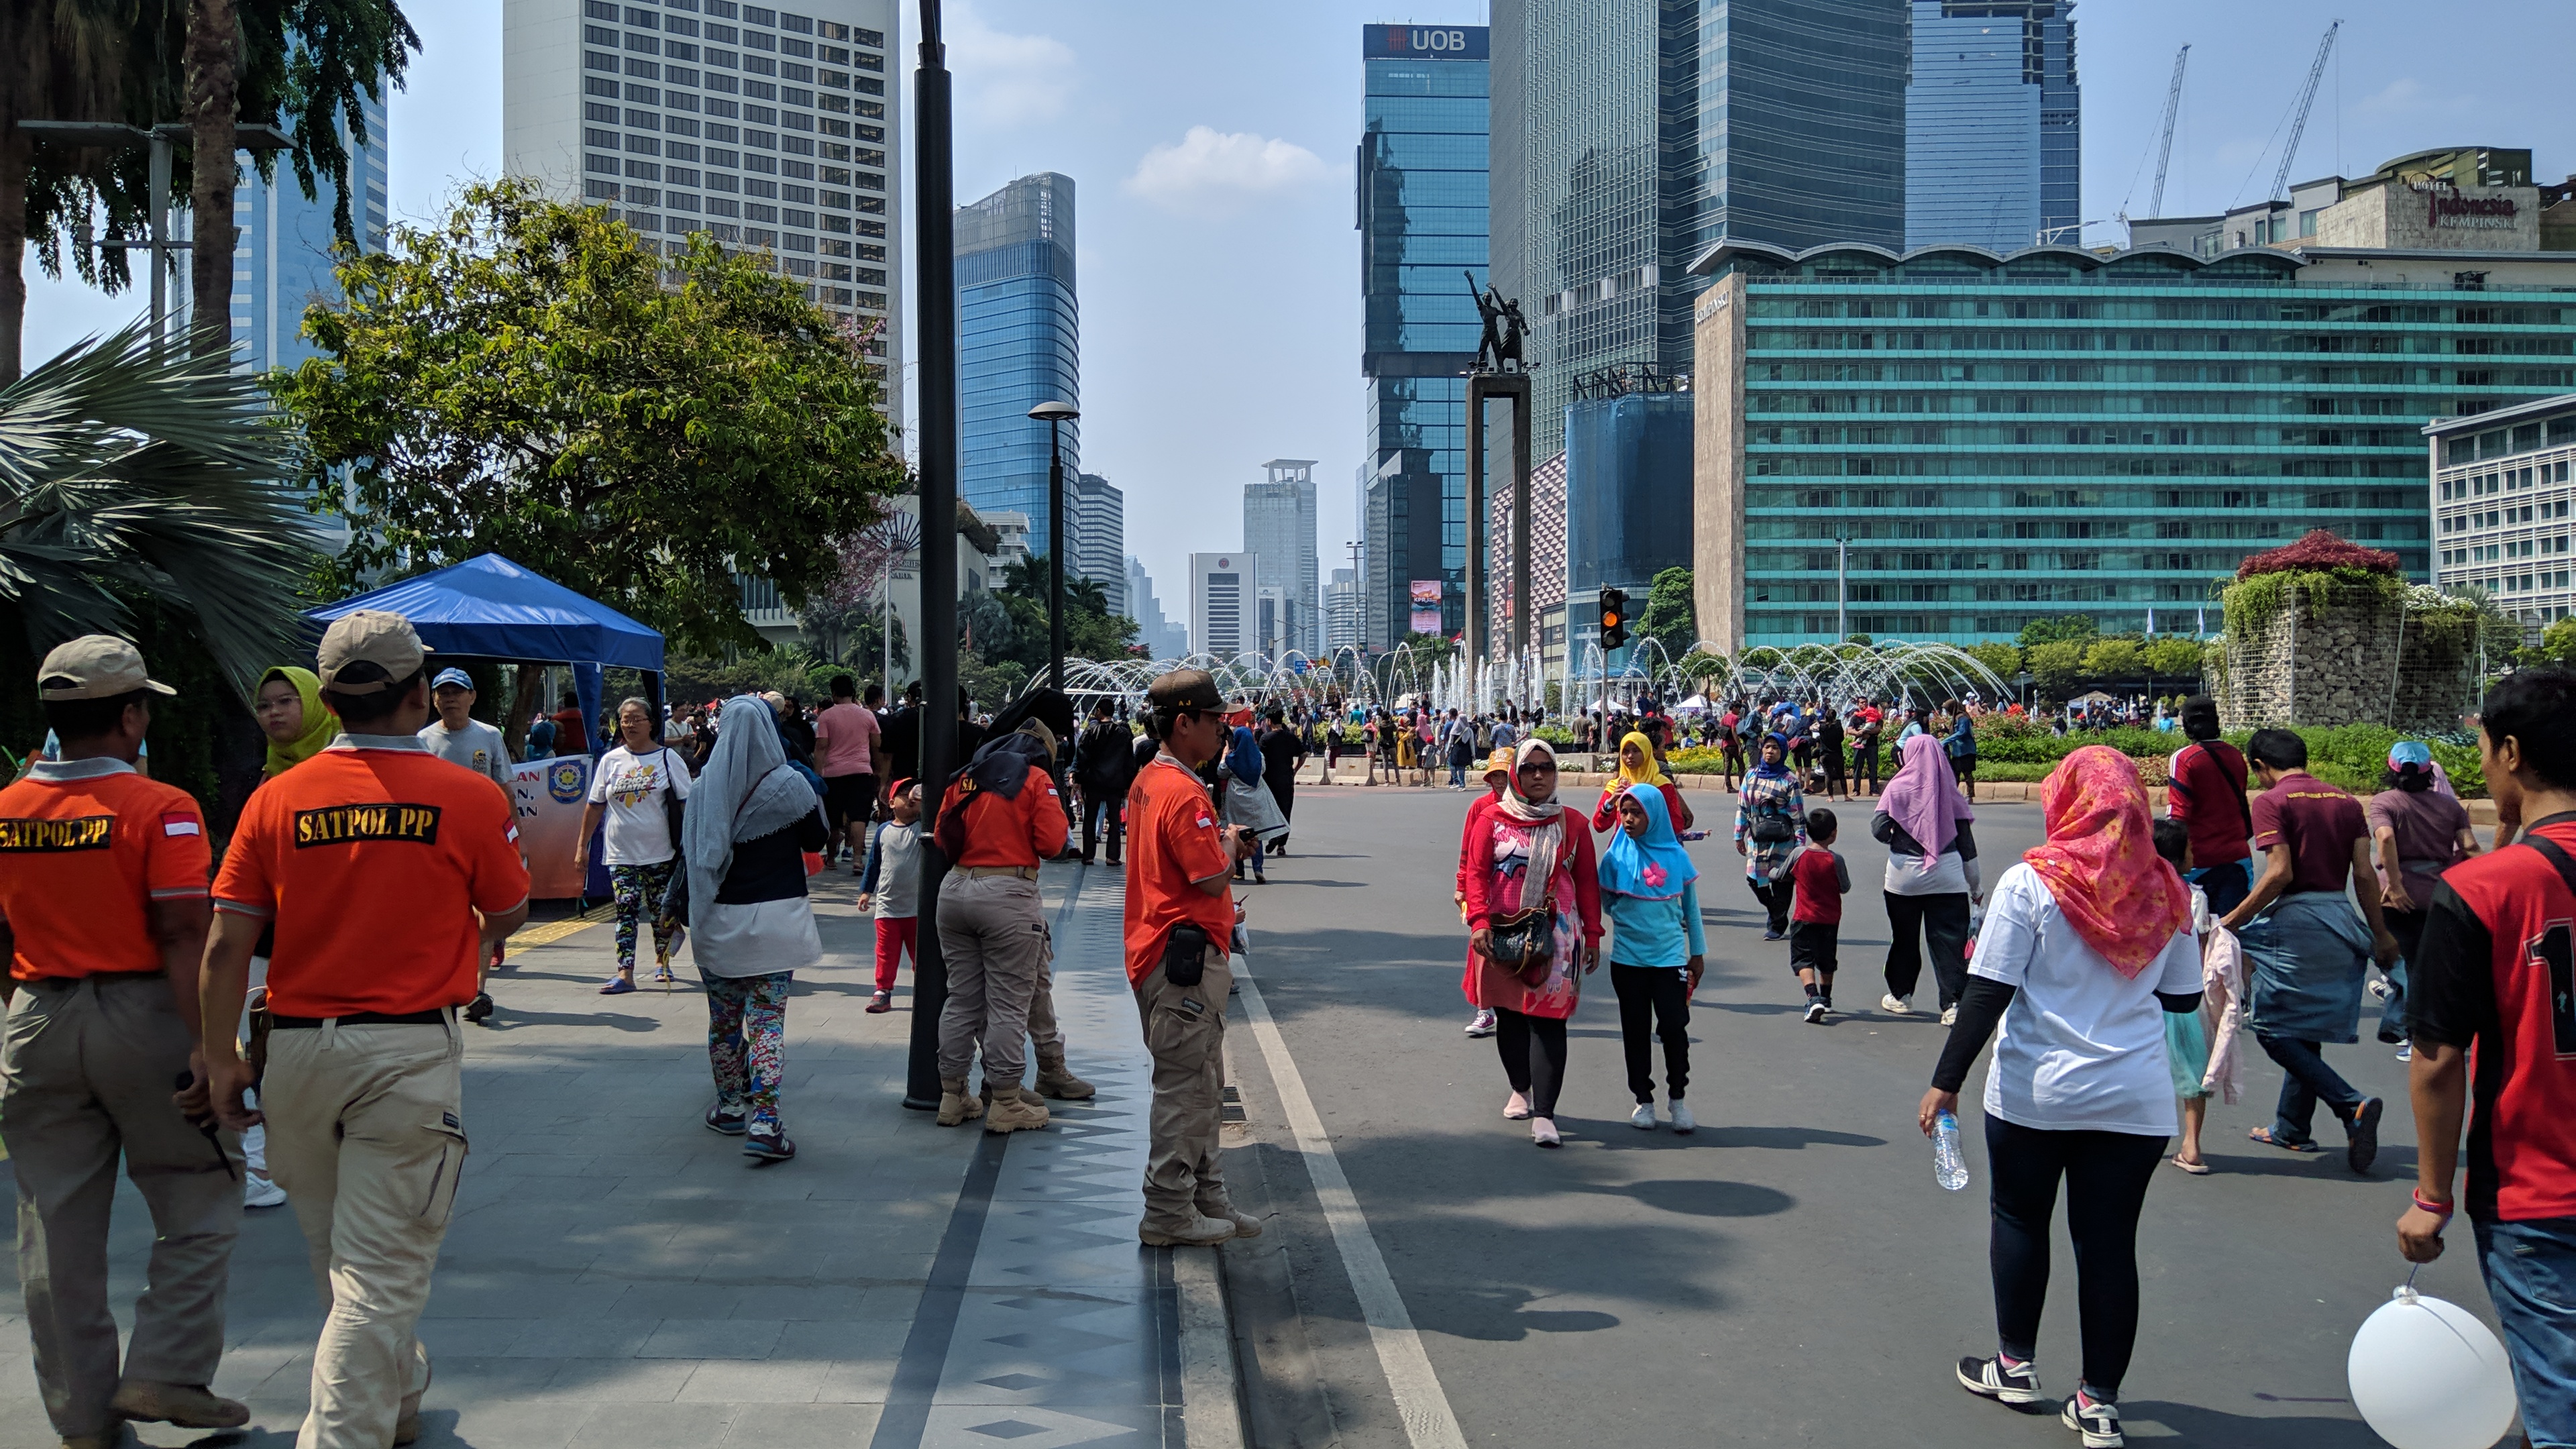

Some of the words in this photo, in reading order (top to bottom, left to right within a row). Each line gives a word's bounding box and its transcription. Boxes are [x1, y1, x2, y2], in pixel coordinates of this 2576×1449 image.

[1412, 30, 1466, 51] UOB
[2414, 180, 2448, 192] HOTEL
[2414, 174, 2520, 228] Indonesia
[2440, 216, 2518, 229] KEMPINSKI
[79, 818, 108, 845] PP
[299, 808, 392, 843] SATPOL
[398, 808, 433, 837] PP
